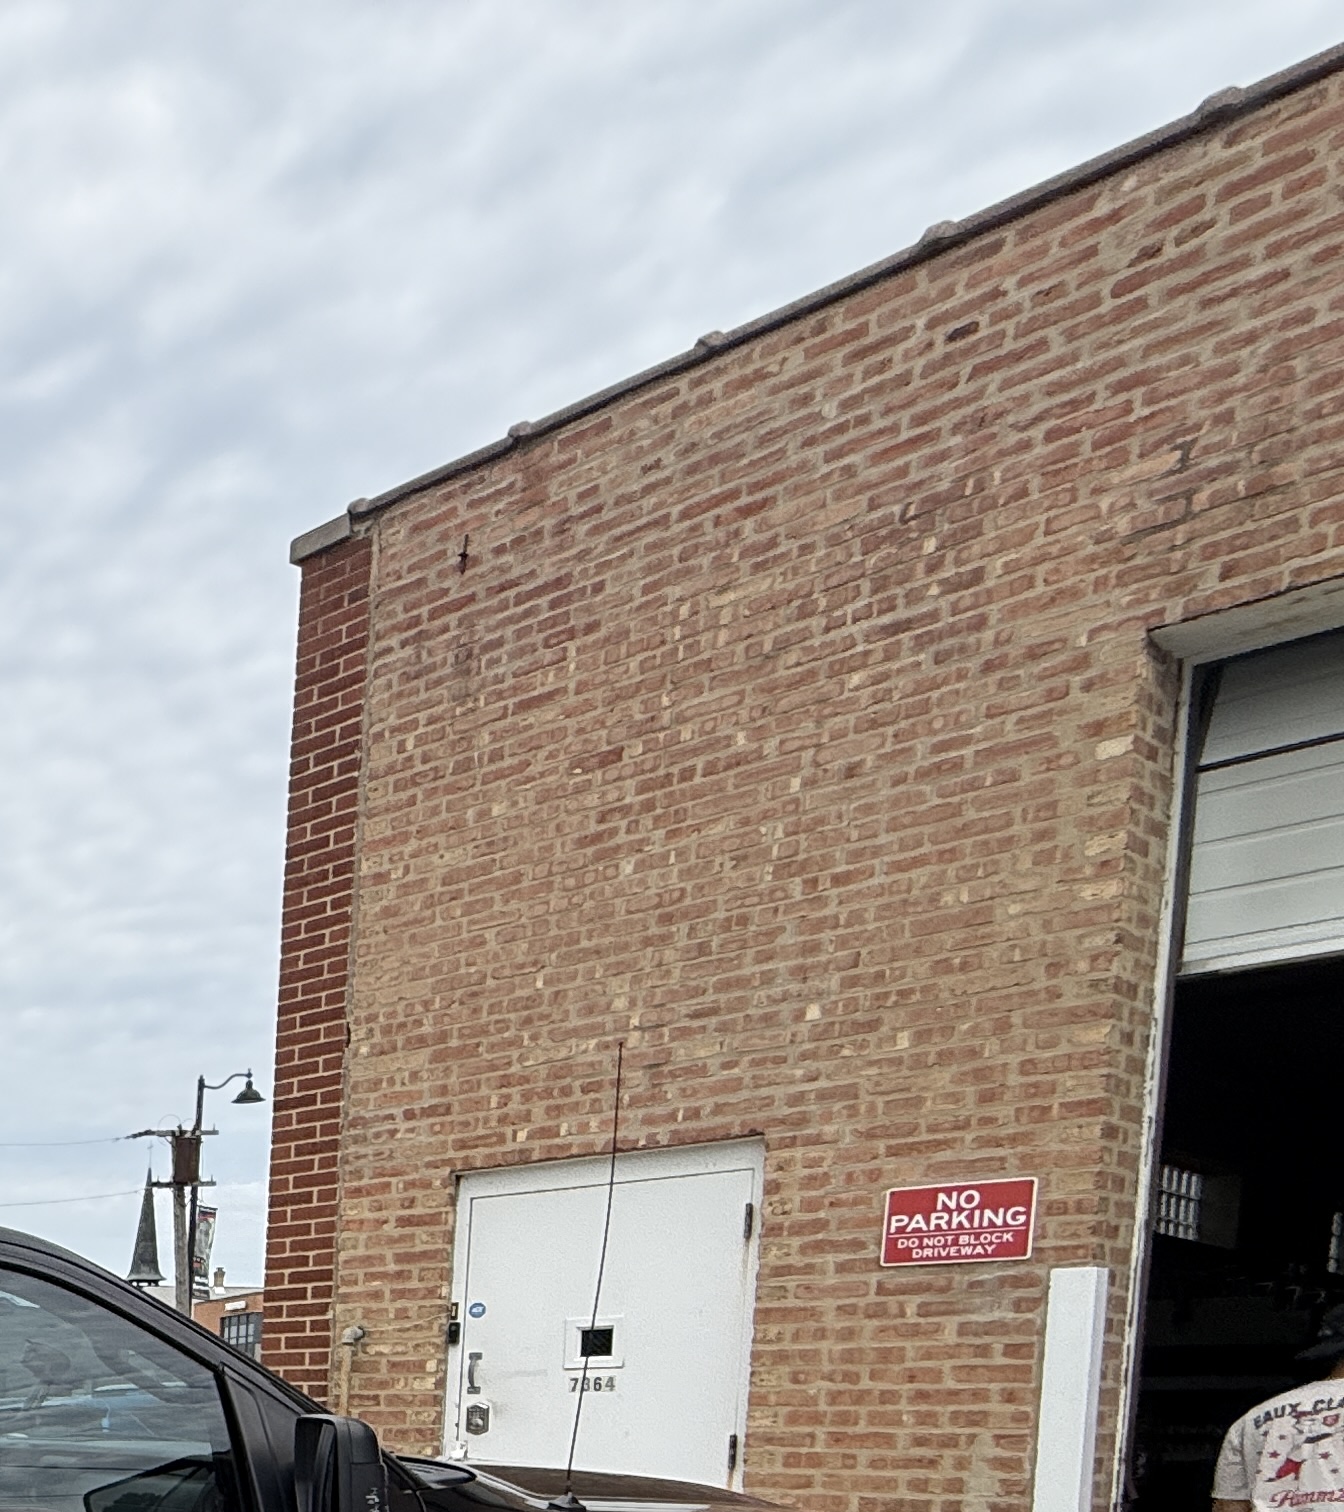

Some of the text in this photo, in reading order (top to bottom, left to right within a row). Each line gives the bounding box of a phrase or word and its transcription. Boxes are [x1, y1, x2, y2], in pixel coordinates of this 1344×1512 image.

[936, 1190, 981, 1211] NO
[889, 1206, 1027, 1234] PARKING
[897, 1231, 1014, 1249] DO NOT BLOCK
[911, 1244, 997, 1259] DRIVEWAY
[1253, 1402, 1302, 1429] EAUX
